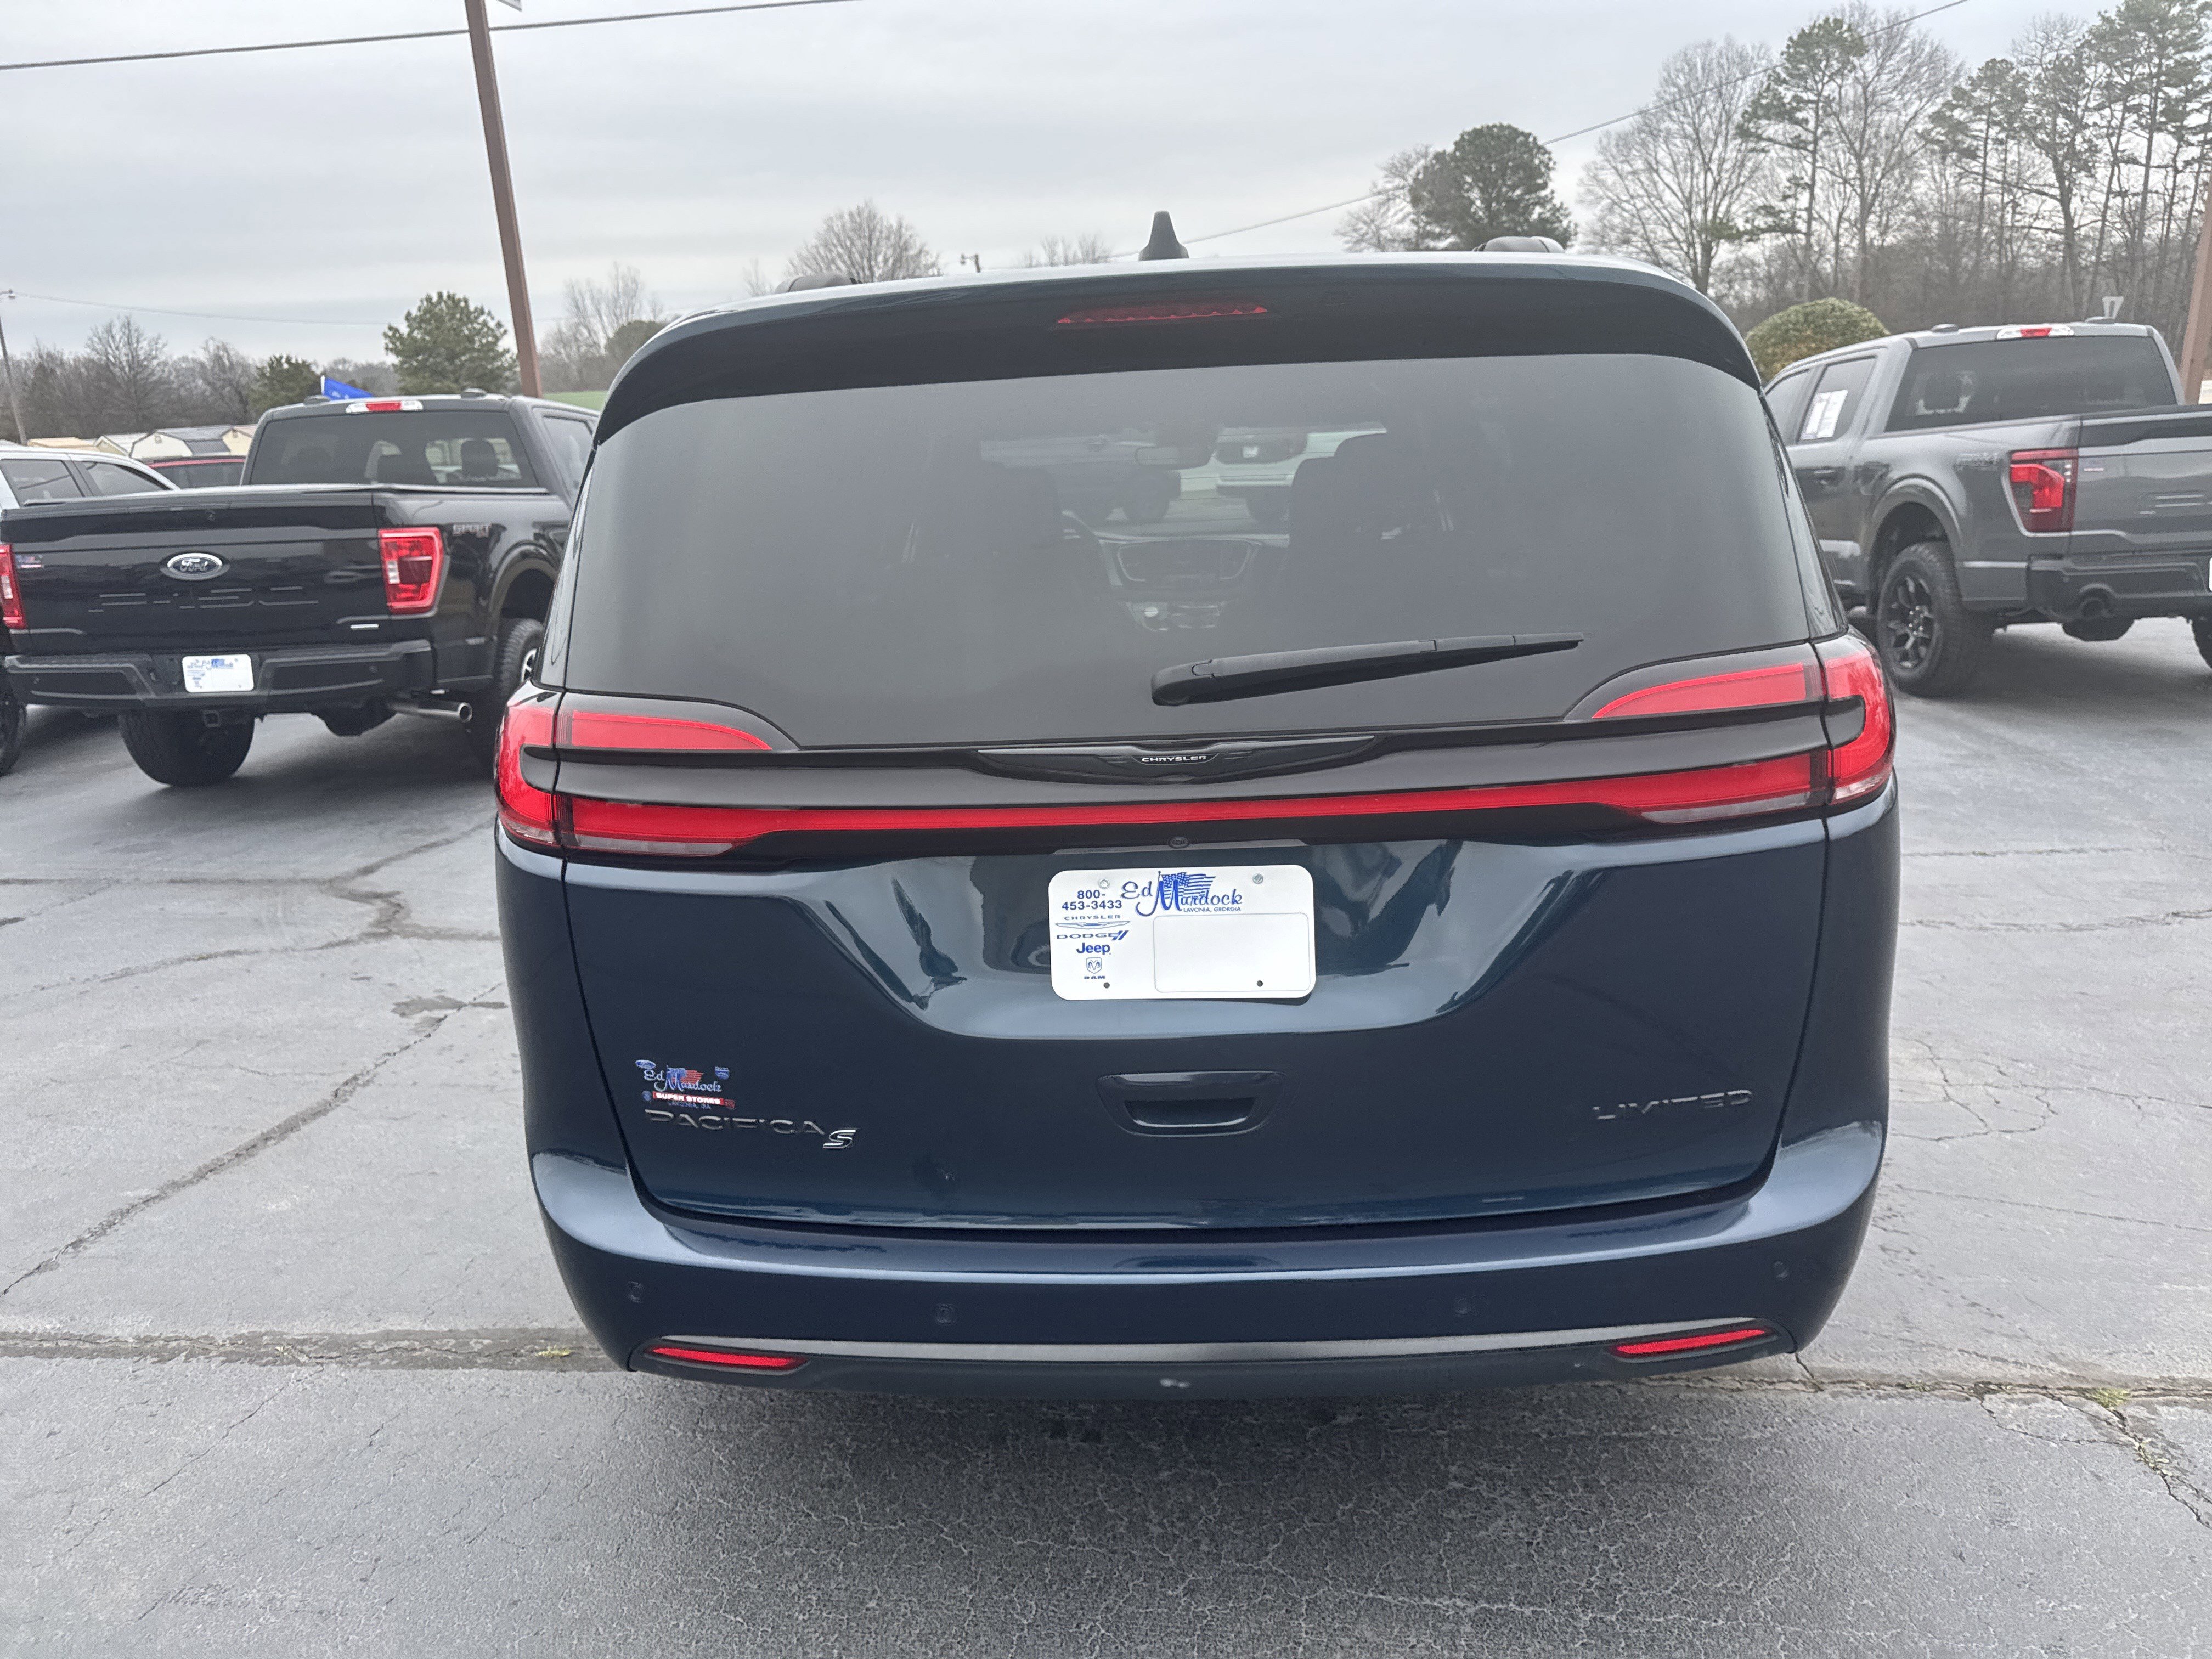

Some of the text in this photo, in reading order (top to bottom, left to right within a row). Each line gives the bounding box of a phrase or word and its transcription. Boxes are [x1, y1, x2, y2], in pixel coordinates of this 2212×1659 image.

[1077, 889, 1106, 899] 800-
[1120, 876, 1243, 917] Ed Murdock
[1062, 900, 1122, 911] 453-3433
[1076, 942, 1110, 955] Jeep
[644, 1069, 665, 1081] Ed
[656, 1092, 721, 1104] SUPER STORES
[645, 1109, 857, 1149] PACIFICA S
